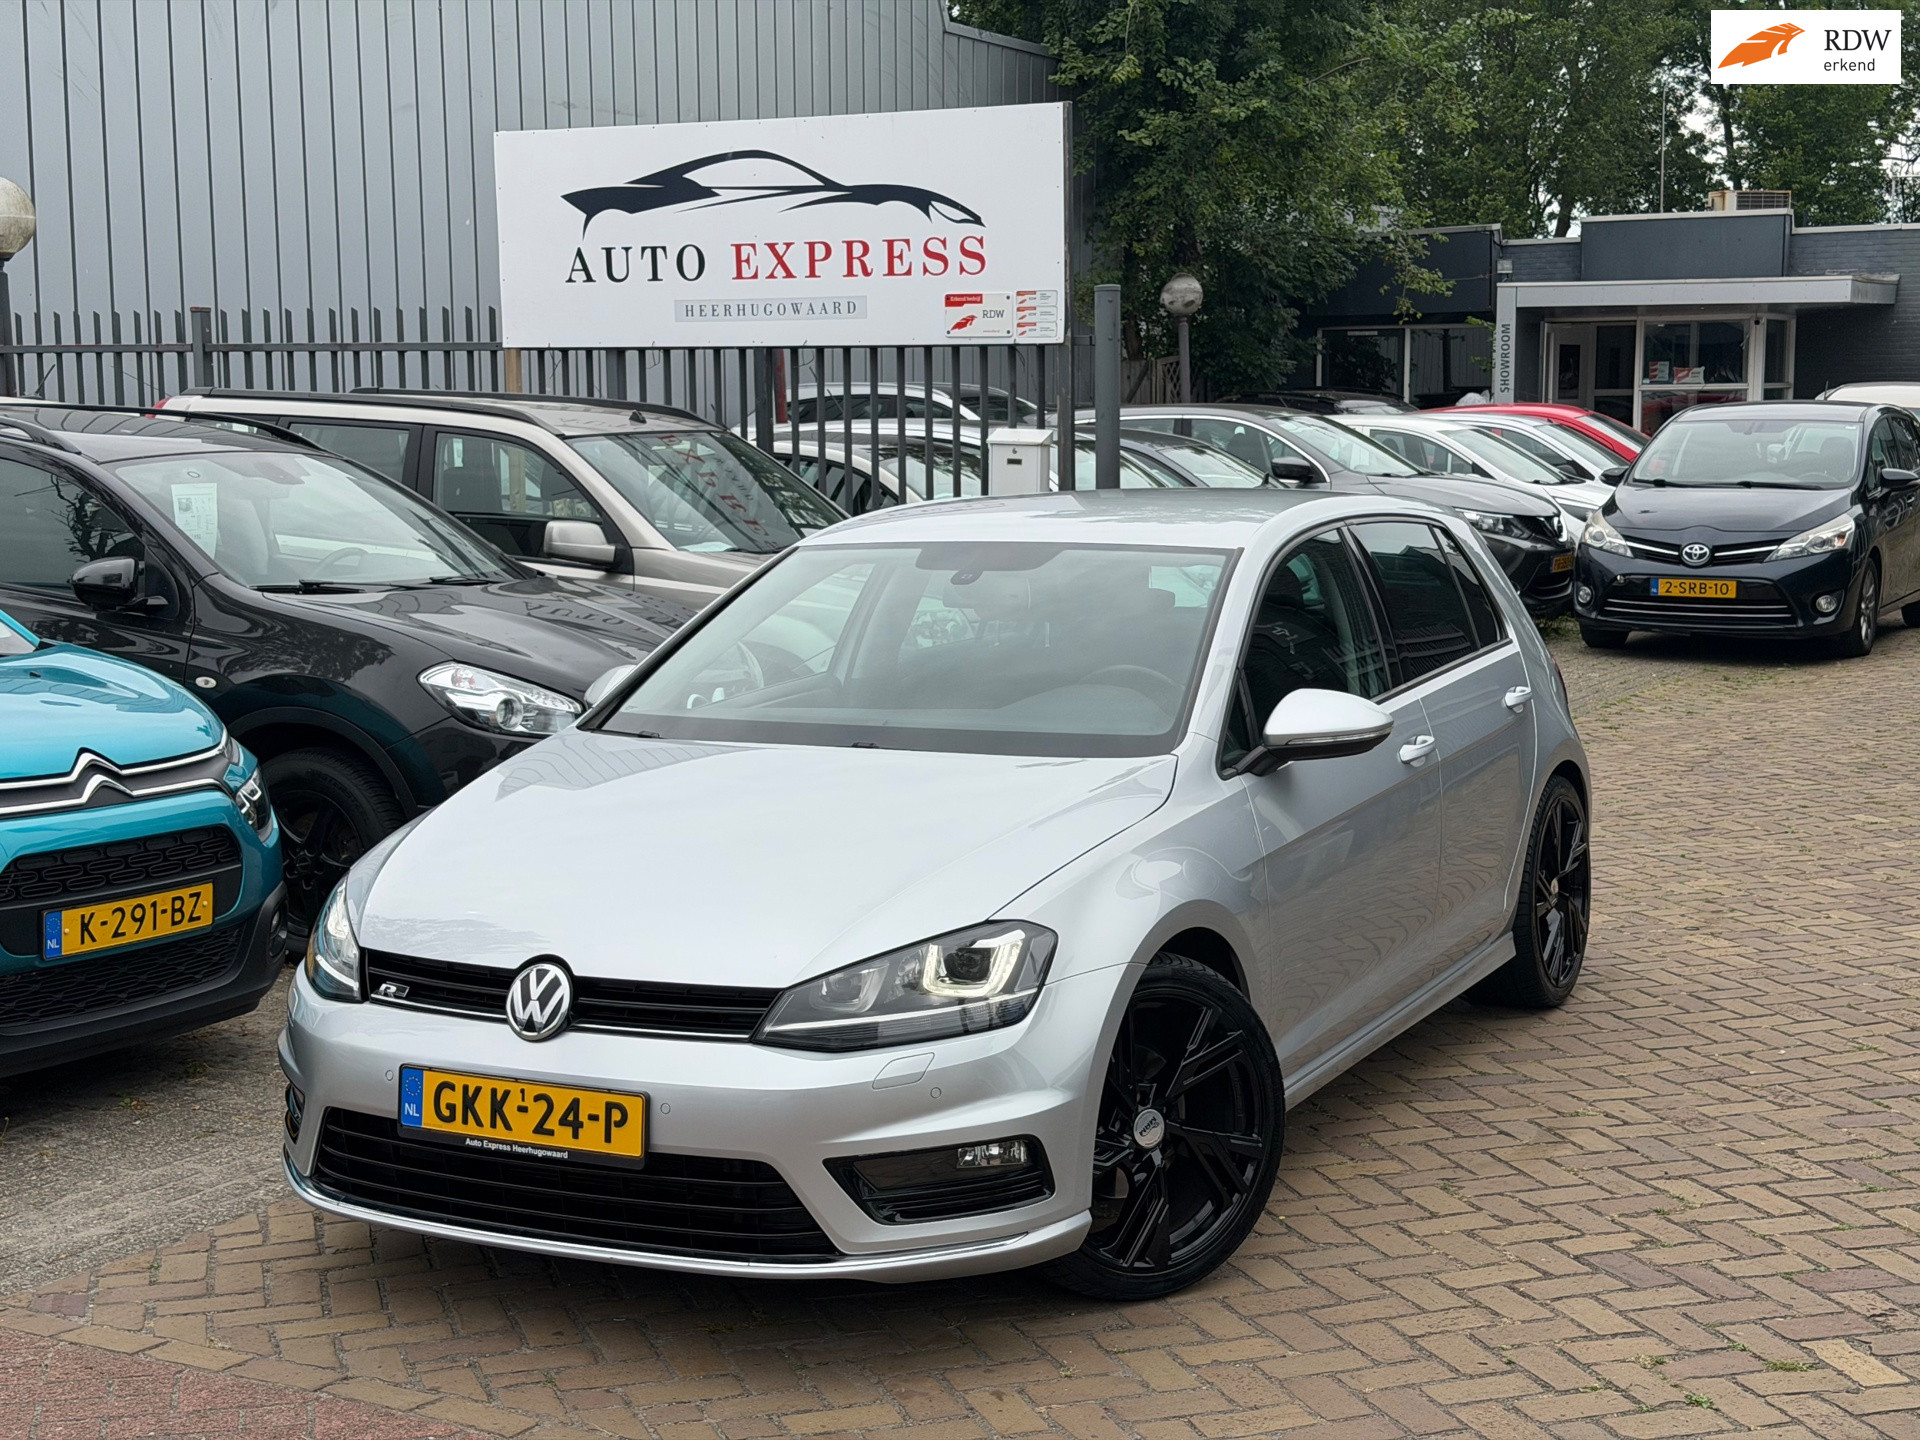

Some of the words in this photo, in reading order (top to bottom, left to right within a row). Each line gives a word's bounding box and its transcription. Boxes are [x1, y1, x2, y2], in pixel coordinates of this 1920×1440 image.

[565, 244, 706, 283] AUTO
[730, 235, 987, 280] EXPRESS
[684, 300, 858, 318] HEERHUGOWAARD
[982, 309, 1005, 319] RDW
[1500, 323, 1511, 393] SHOWROOM
[1664, 581, 1730, 596] 2-SRB-10
[79, 890, 202, 946] K-291-BZ
[47, 938, 60, 950] NL
[404, 1102, 420, 1117] NL
[433, 1080, 629, 1144] GKK-24-P
[465, 1137, 483, 1147] Auto
[483, 1140, 512, 1151] Express
[512, 1144, 569, 1159] Heerhugowaard
